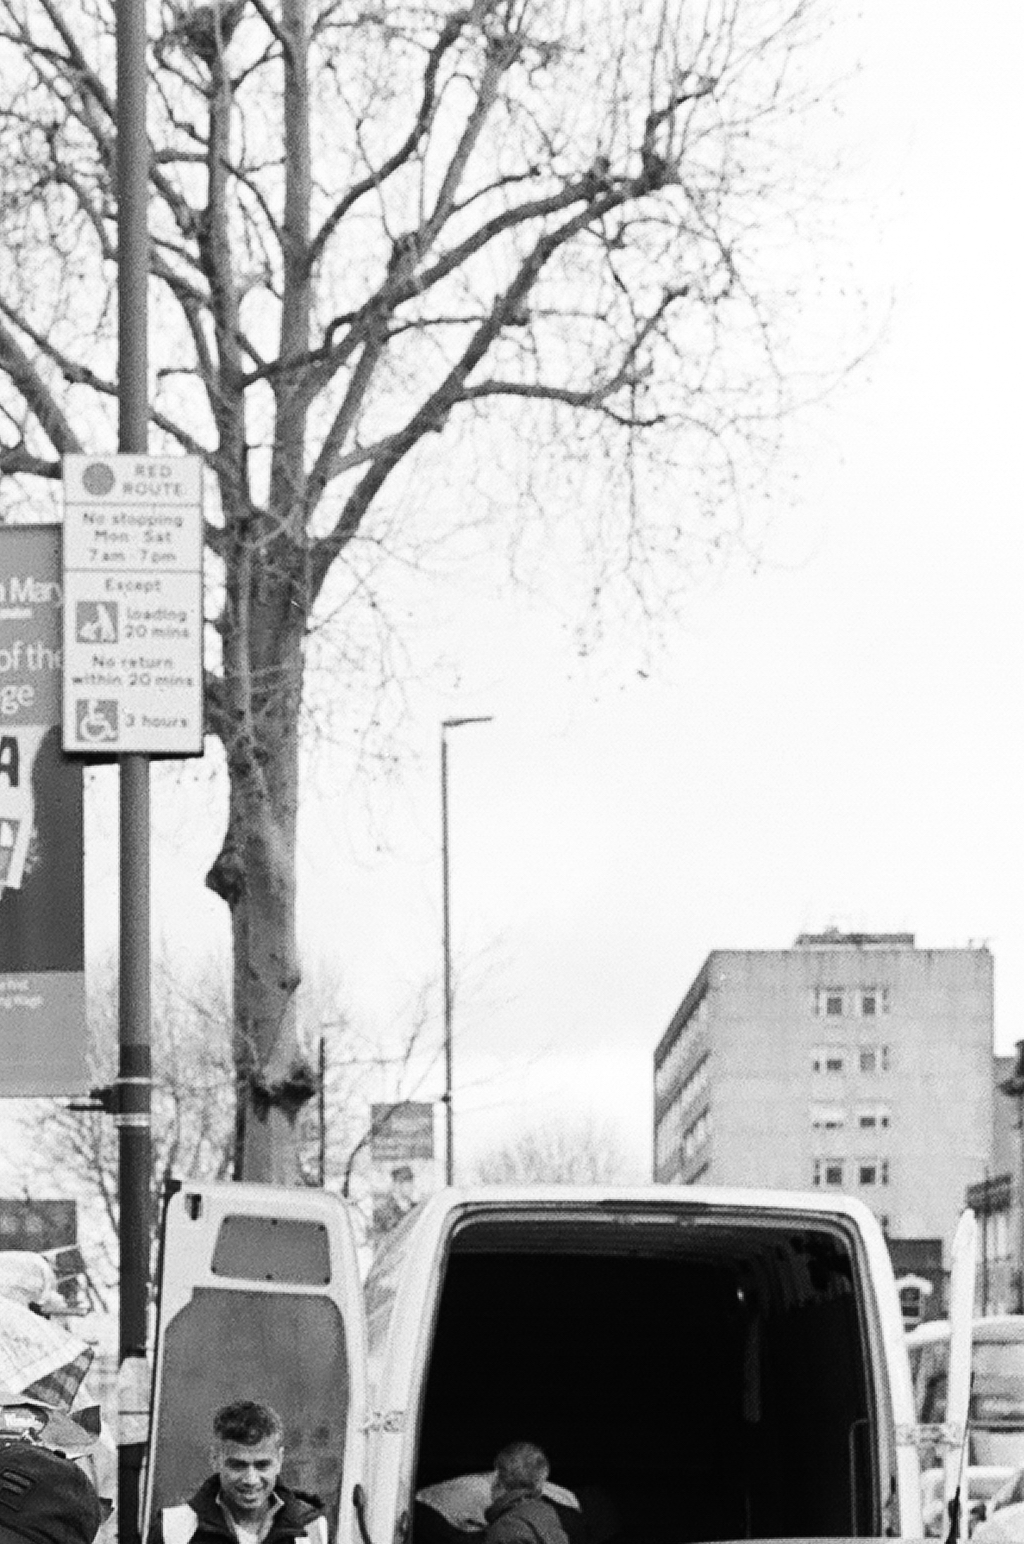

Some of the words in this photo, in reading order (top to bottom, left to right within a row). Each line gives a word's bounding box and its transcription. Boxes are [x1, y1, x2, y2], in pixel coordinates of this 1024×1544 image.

[135, 464, 172, 478] RED
[123, 482, 181, 496] ROUTE
[83, 513, 105, 525] No
[112, 513, 183, 528] stopping
[94, 530, 129, 542] Mon
[144, 530, 172, 542] Sat
[105, 577, 161, 594] Except
[124, 624, 148, 638] 20
[151, 625, 189, 638] mins
[92, 654, 116, 667] No
[121, 656, 173, 668] return
[72, 672, 121, 685] within
[128, 672, 151, 686] 20
[155, 673, 193, 687] mins
[142, 714, 188, 727] hours
